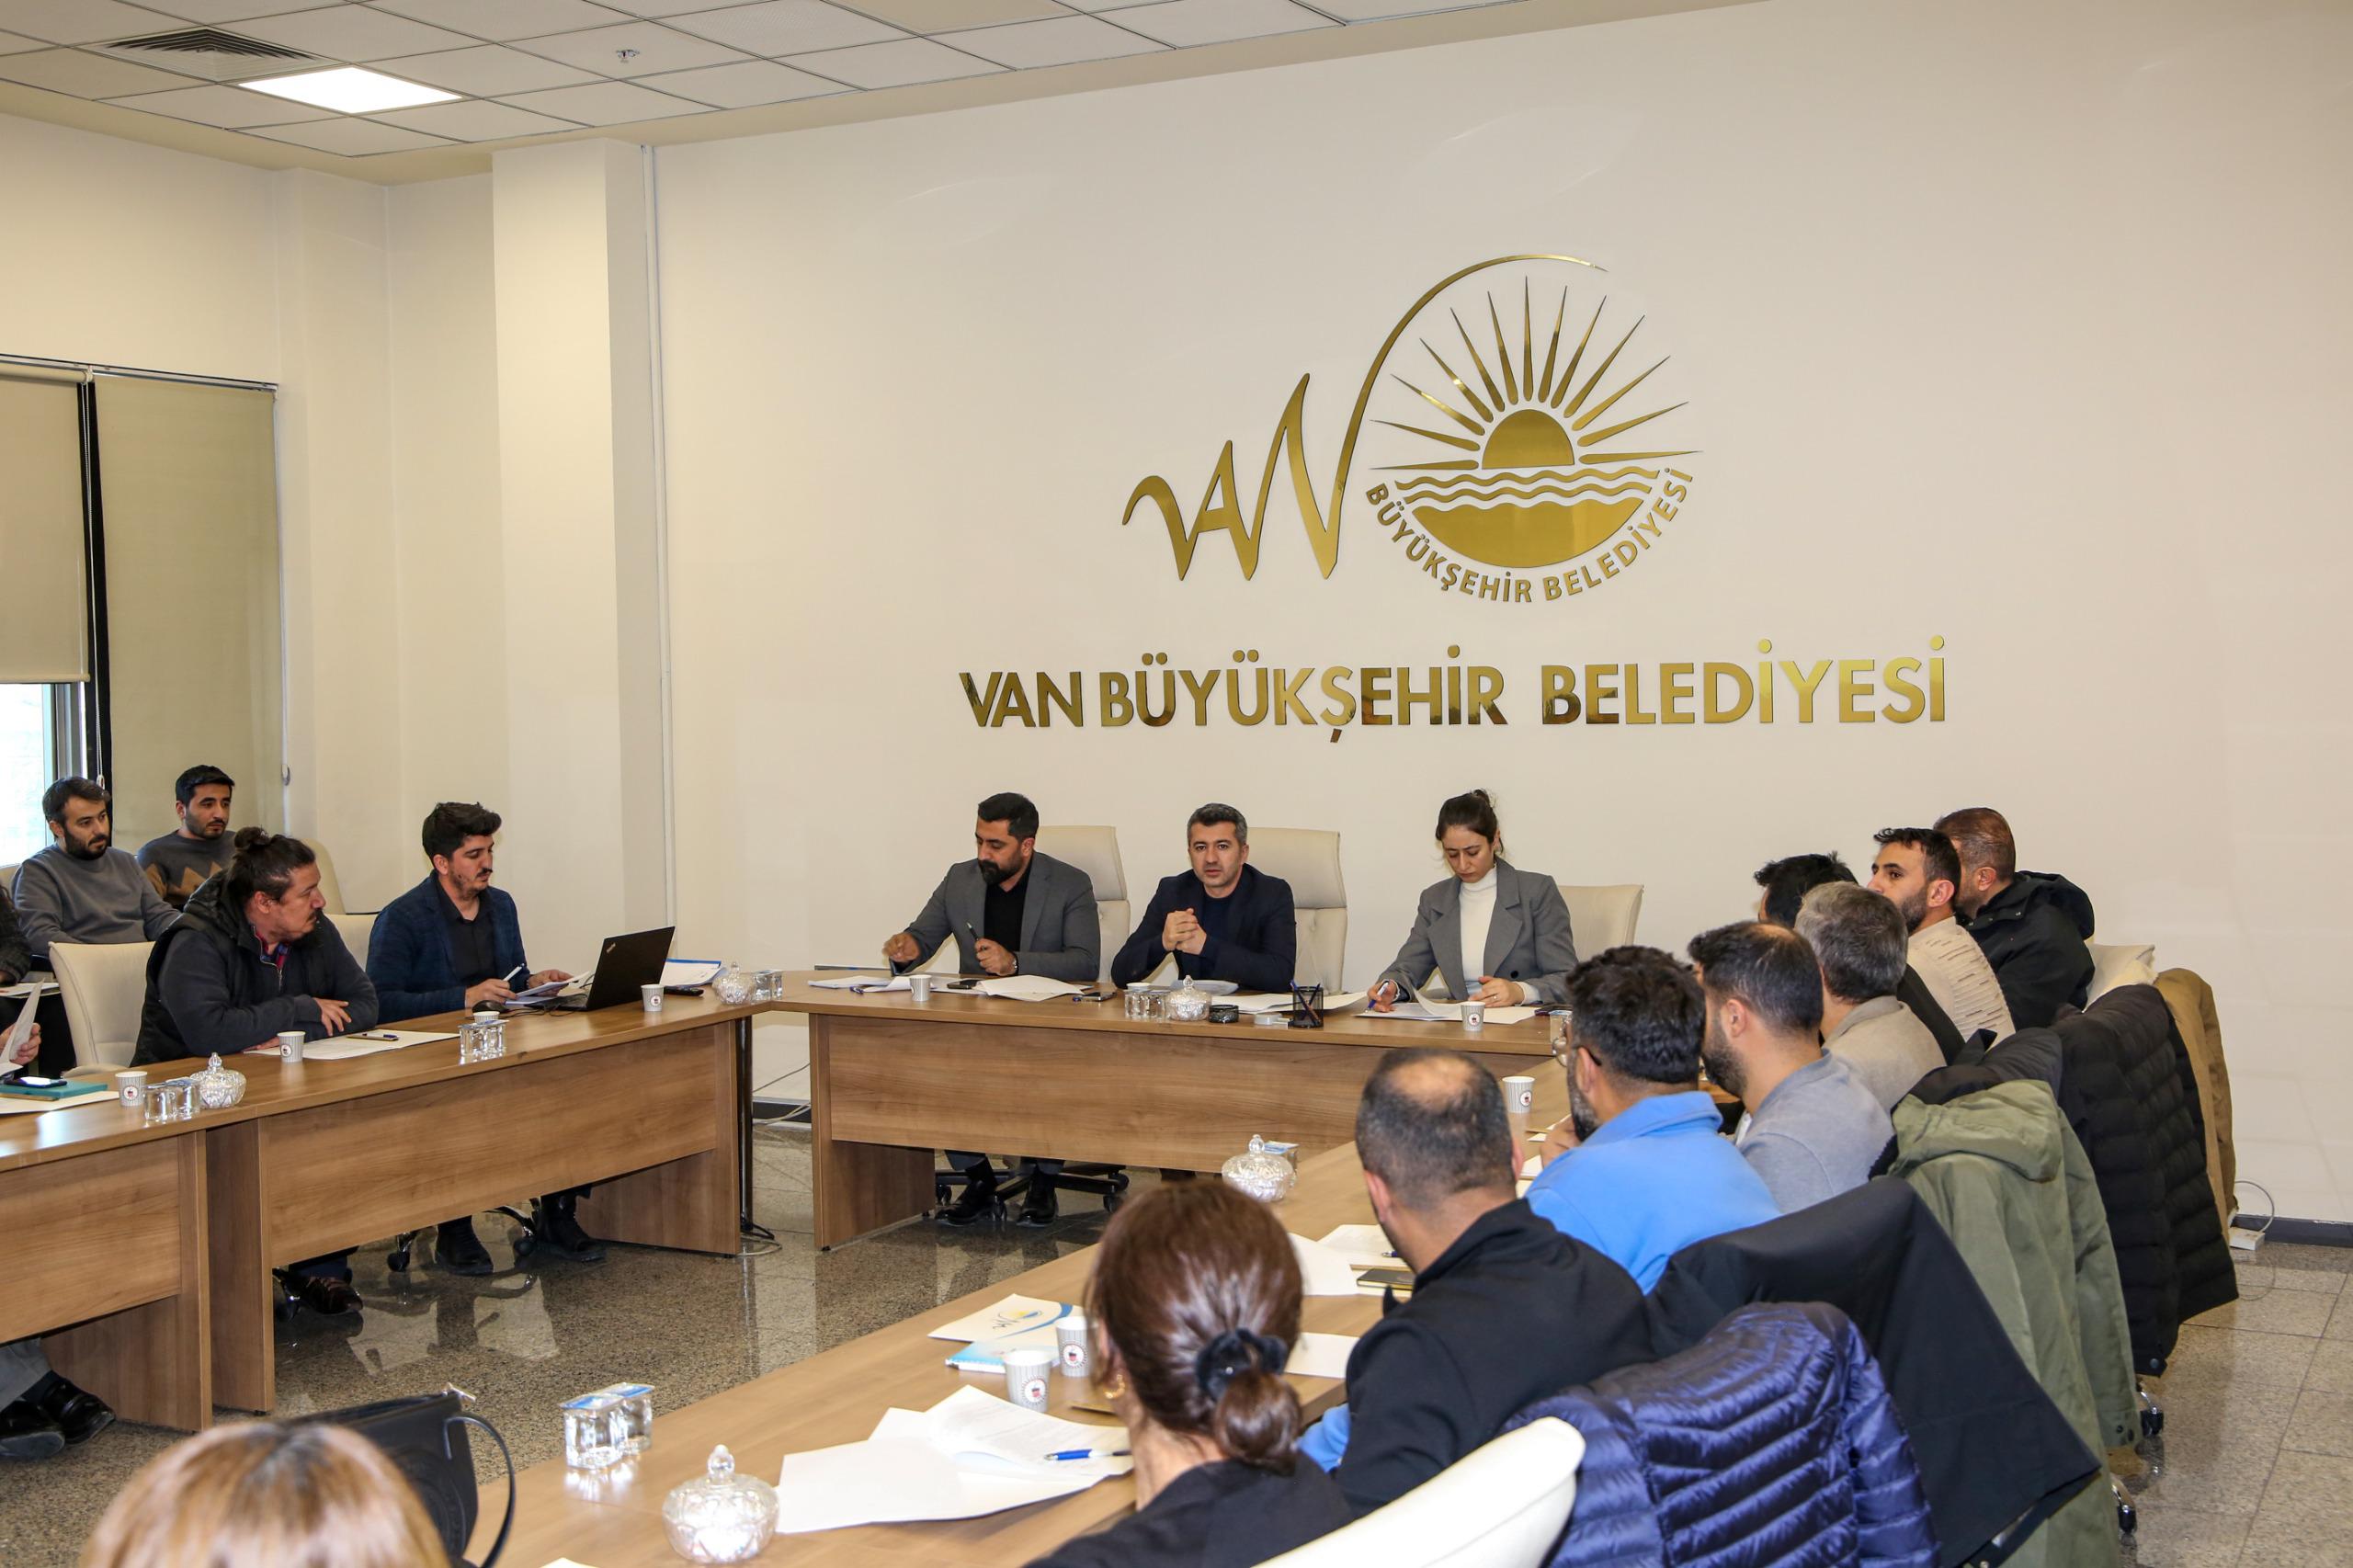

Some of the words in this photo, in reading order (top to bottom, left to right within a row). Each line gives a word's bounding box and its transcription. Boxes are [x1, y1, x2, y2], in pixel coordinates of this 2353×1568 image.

[1365, 483, 1532, 603] BÜYÜKŞEHİR
[1543, 467, 1694, 602] BELEDİYESİ
[958, 671, 1085, 729] VAN
[1098, 644, 1508, 744] BÜYÜKŞEHİR
[1540, 635, 1946, 725] BELEDİYESİ
